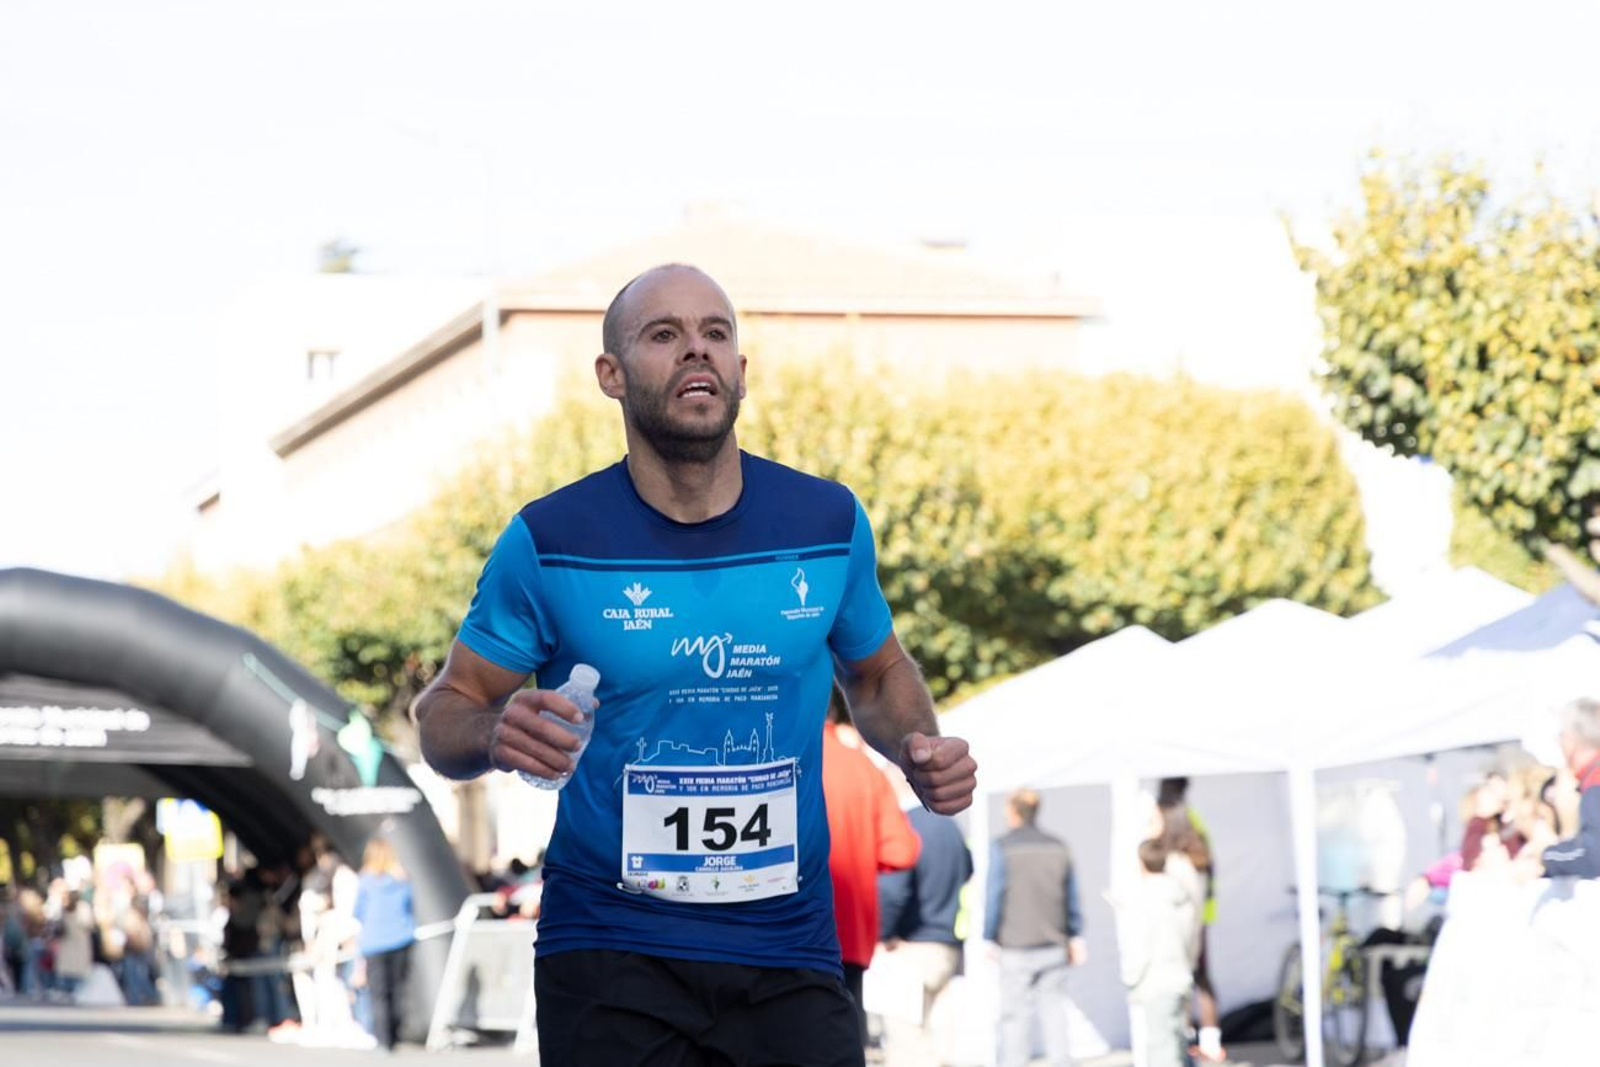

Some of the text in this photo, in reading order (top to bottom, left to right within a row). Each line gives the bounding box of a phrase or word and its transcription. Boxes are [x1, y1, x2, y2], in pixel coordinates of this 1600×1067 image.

[634, 607, 674, 618] RURAL
[733, 645, 767, 654] MEDIA
[730, 656, 780, 666] MARATÓN
[726, 667, 752, 678] JAÉN
[679, 777, 694, 785] XXIX
[695, 777, 715, 785] MEDIA
[716, 776, 746, 785] MARATÓN
[664, 803, 771, 851] 154
[704, 856, 736, 866] JORGE
